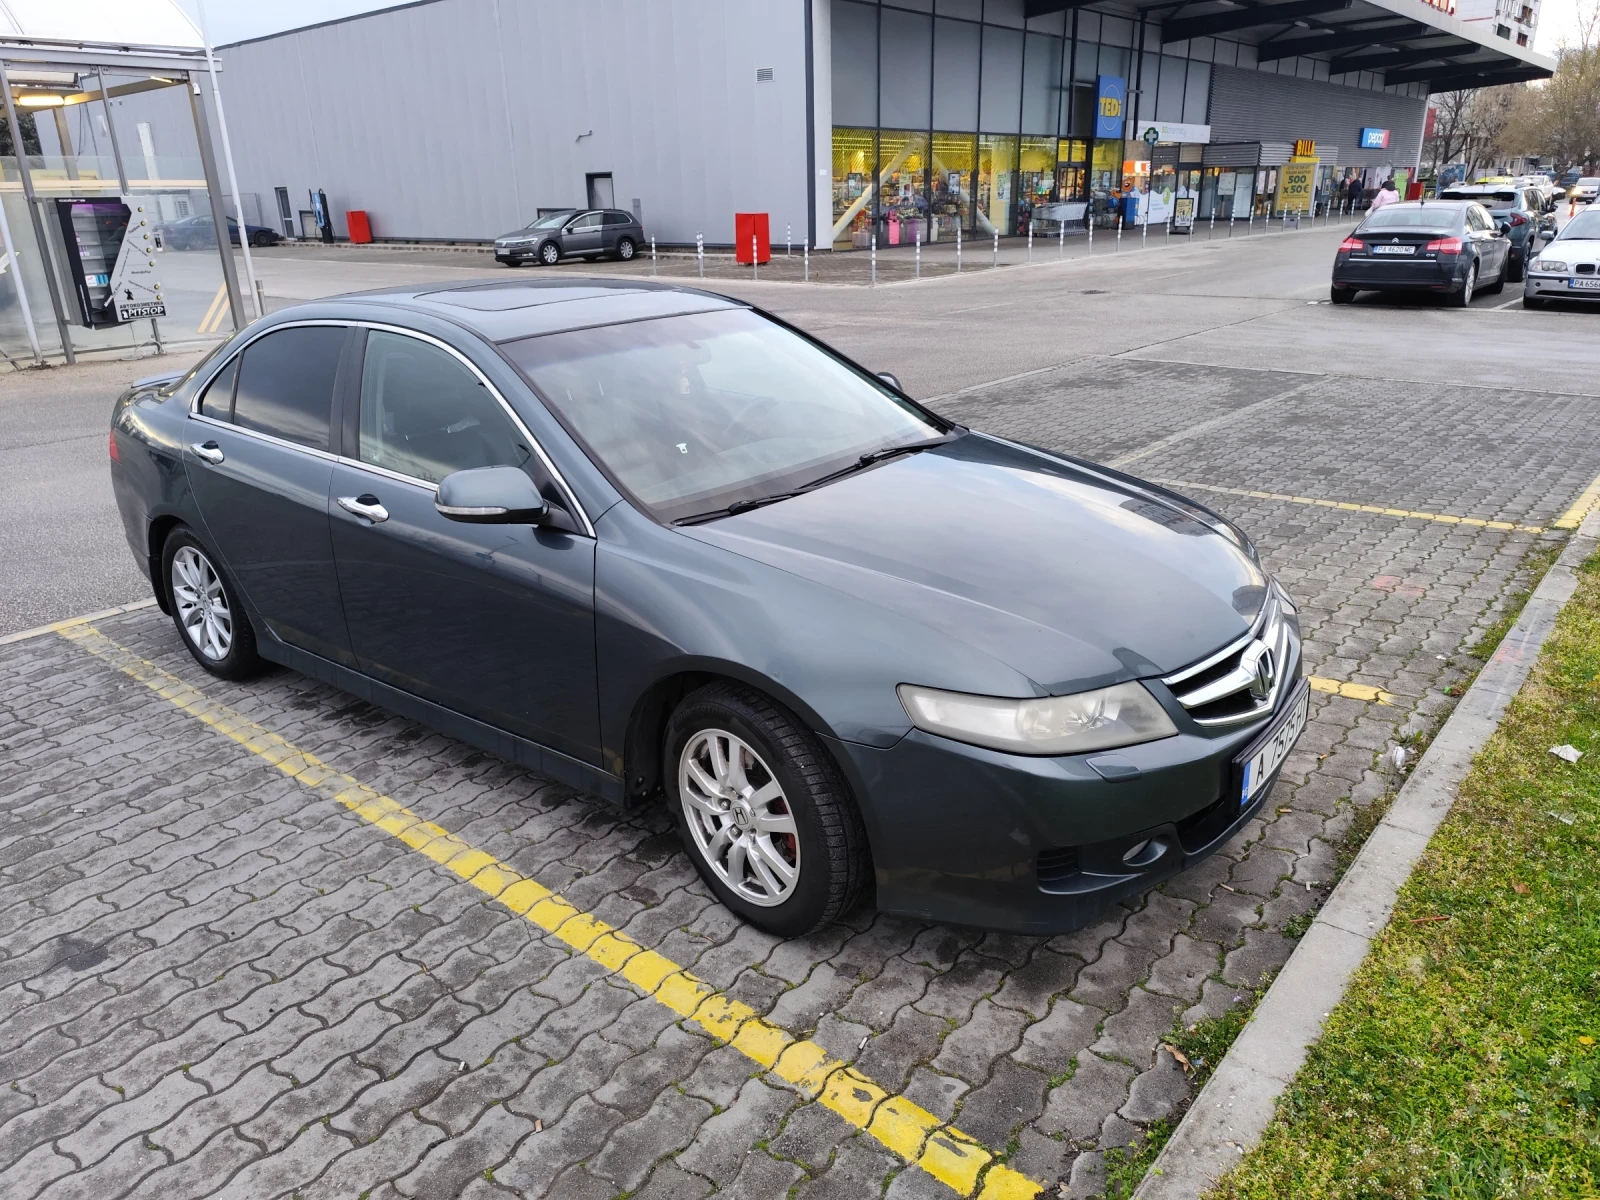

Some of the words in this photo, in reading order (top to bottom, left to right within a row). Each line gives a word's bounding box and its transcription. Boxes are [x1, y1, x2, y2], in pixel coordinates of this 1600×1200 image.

[1100, 97, 1121, 117] TEDi
[1367, 132, 1384, 145] pepco
[1296, 139, 1315, 156] BILLA
[1288, 175, 1306, 184] 500
[1585, 280, 1600, 288] 656
[128, 306, 164, 316] PITSTOP
[1255, 752, 1264, 786] A
[1270, 712, 1296, 769] 7575
